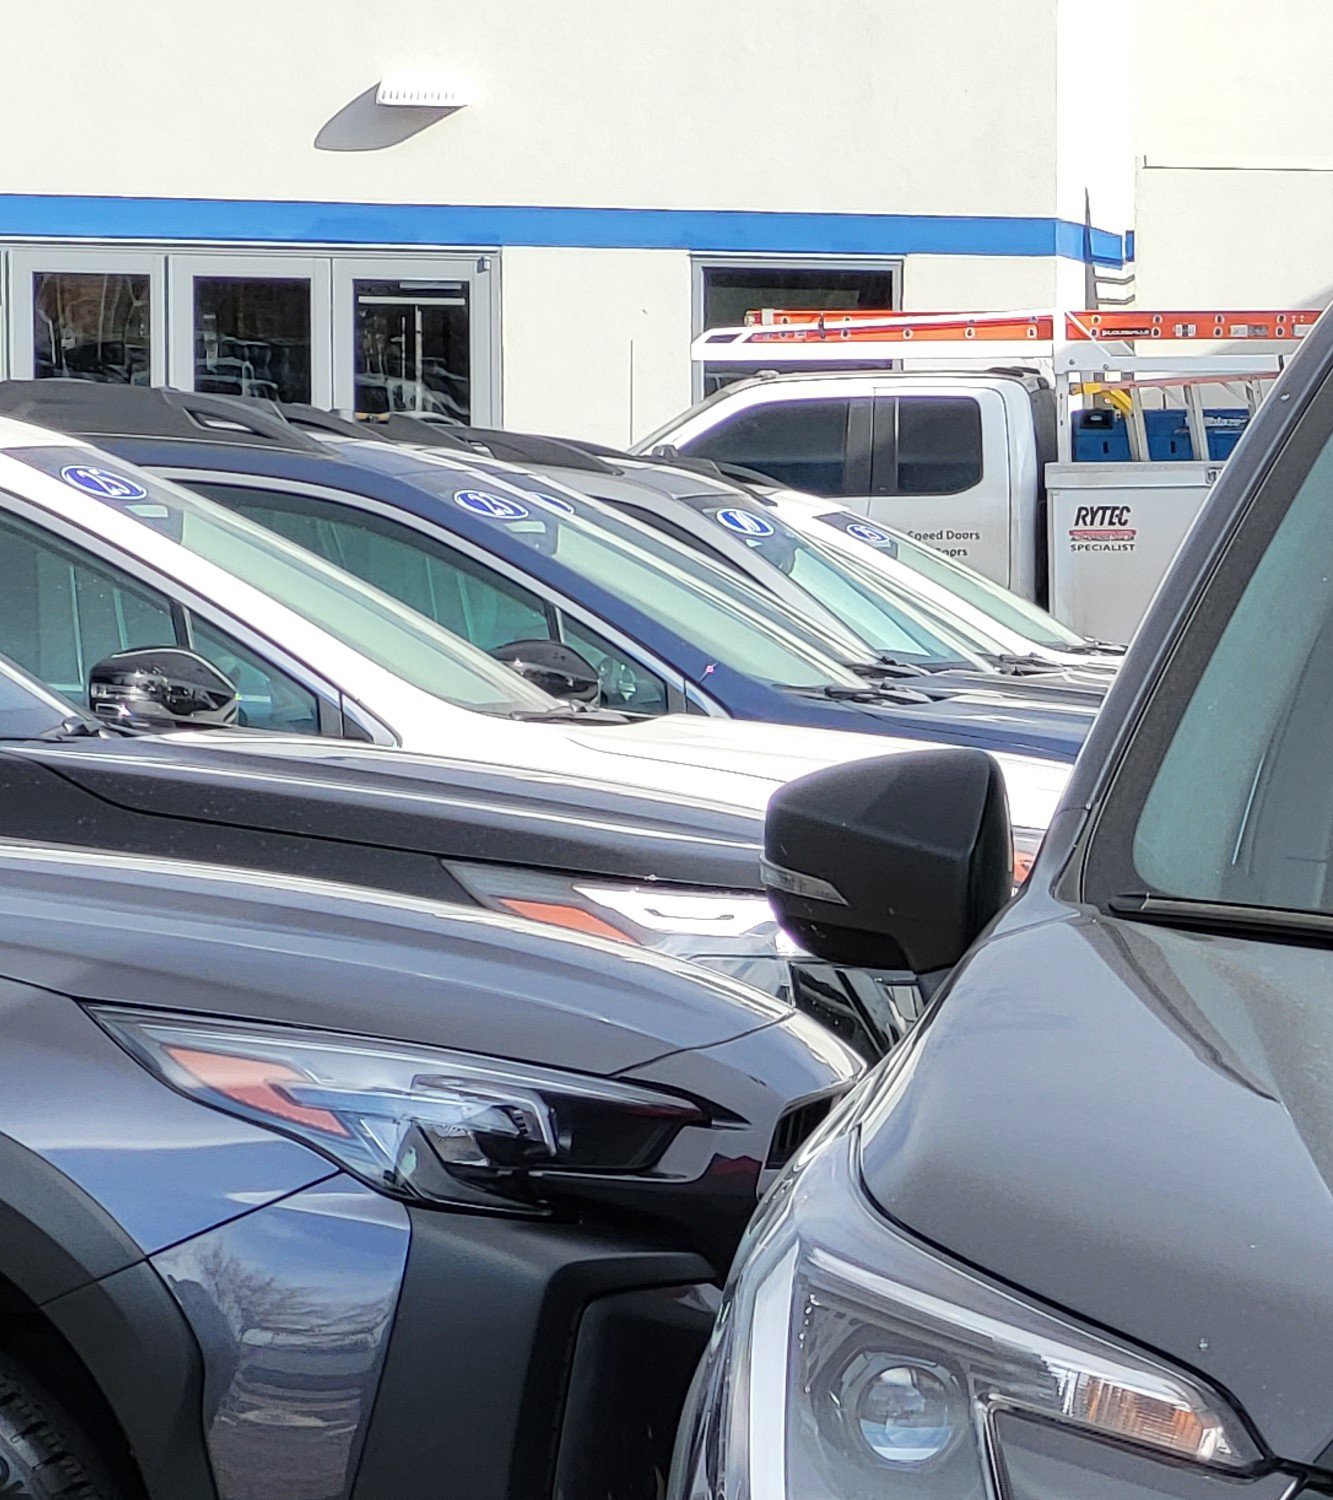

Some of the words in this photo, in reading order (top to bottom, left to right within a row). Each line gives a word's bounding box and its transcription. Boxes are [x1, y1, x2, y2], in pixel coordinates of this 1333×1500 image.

[1074, 505, 1131, 526] RYTEC
[946, 531, 980, 540] Doors
[1070, 544, 1135, 552] SPECIALIST
